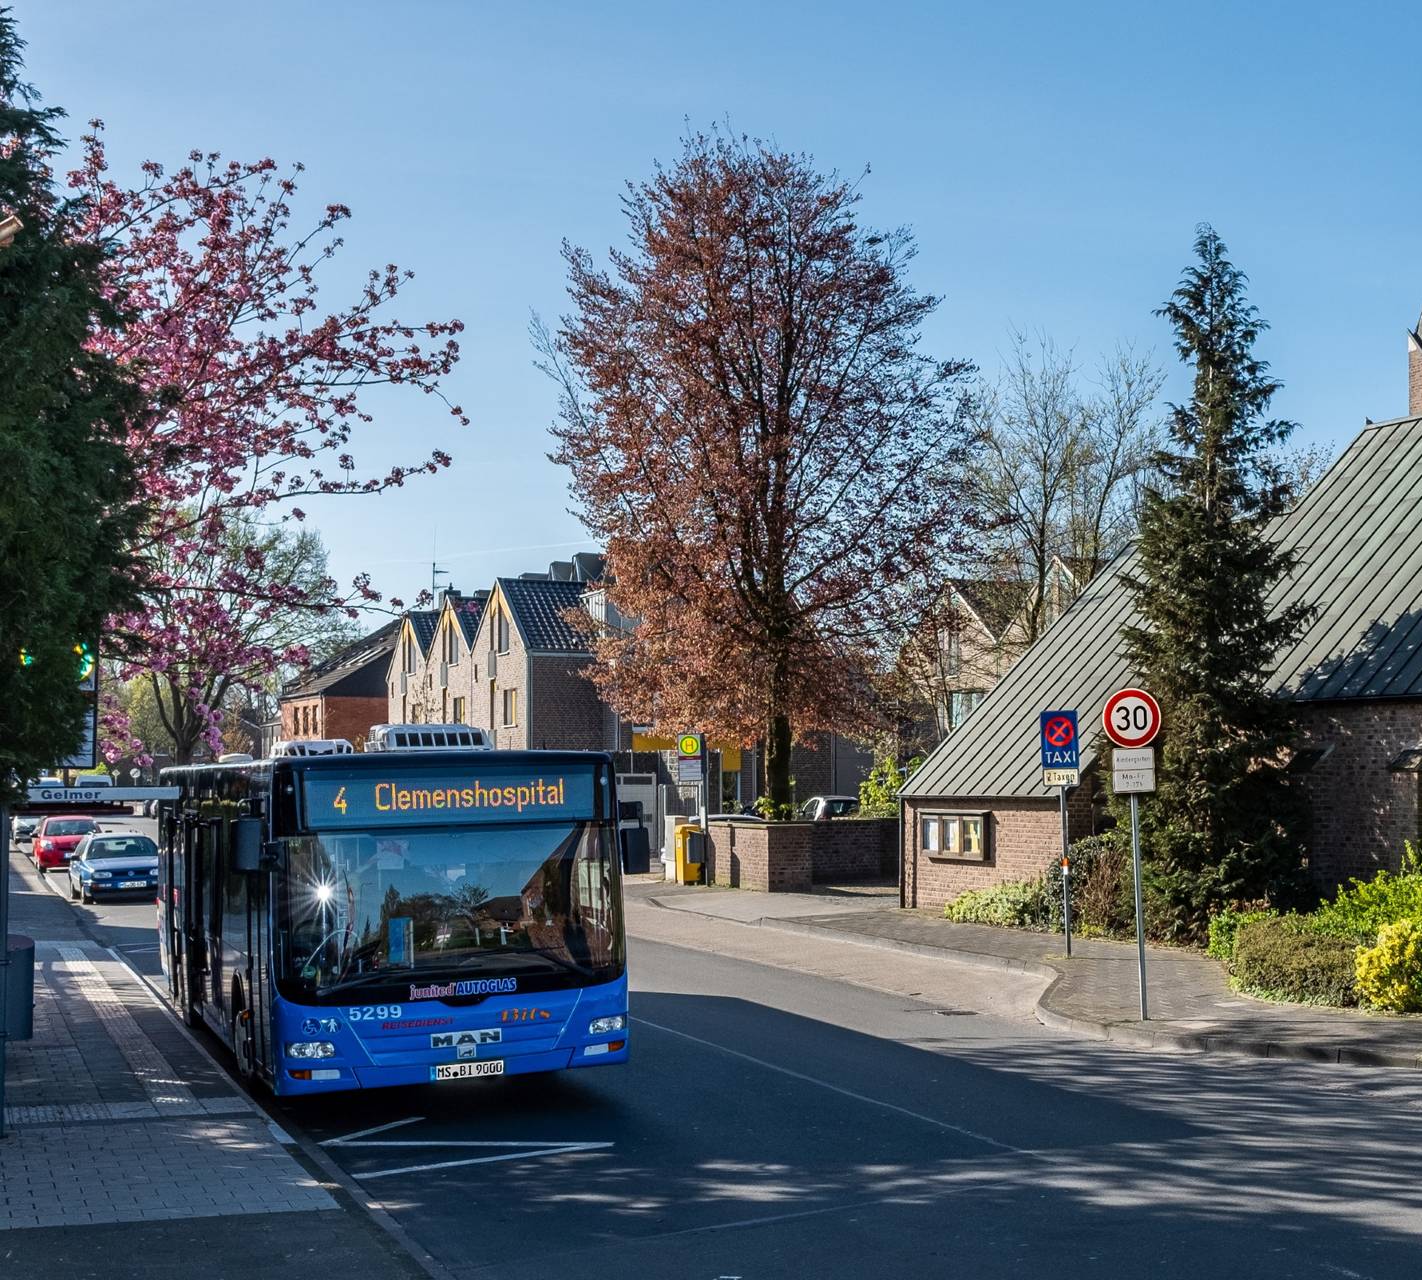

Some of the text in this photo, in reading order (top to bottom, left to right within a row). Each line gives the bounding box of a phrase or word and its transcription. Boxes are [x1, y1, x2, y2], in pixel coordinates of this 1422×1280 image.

[1116, 705, 1148, 731] 30
[685, 740, 694, 751] H
[1045, 751, 1076, 764] TAXI
[1047, 772, 1075, 782] 2 Taxen
[41, 789, 101, 800] Gelmer
[333, 778, 565, 815] 4 Clemenshospital
[410, 978, 517, 1001] junited AUTOGLAS
[349, 1005, 402, 1021] 5299
[431, 1030, 501, 1048] MAN
[437, 1061, 503, 1079] MS BI 9000
